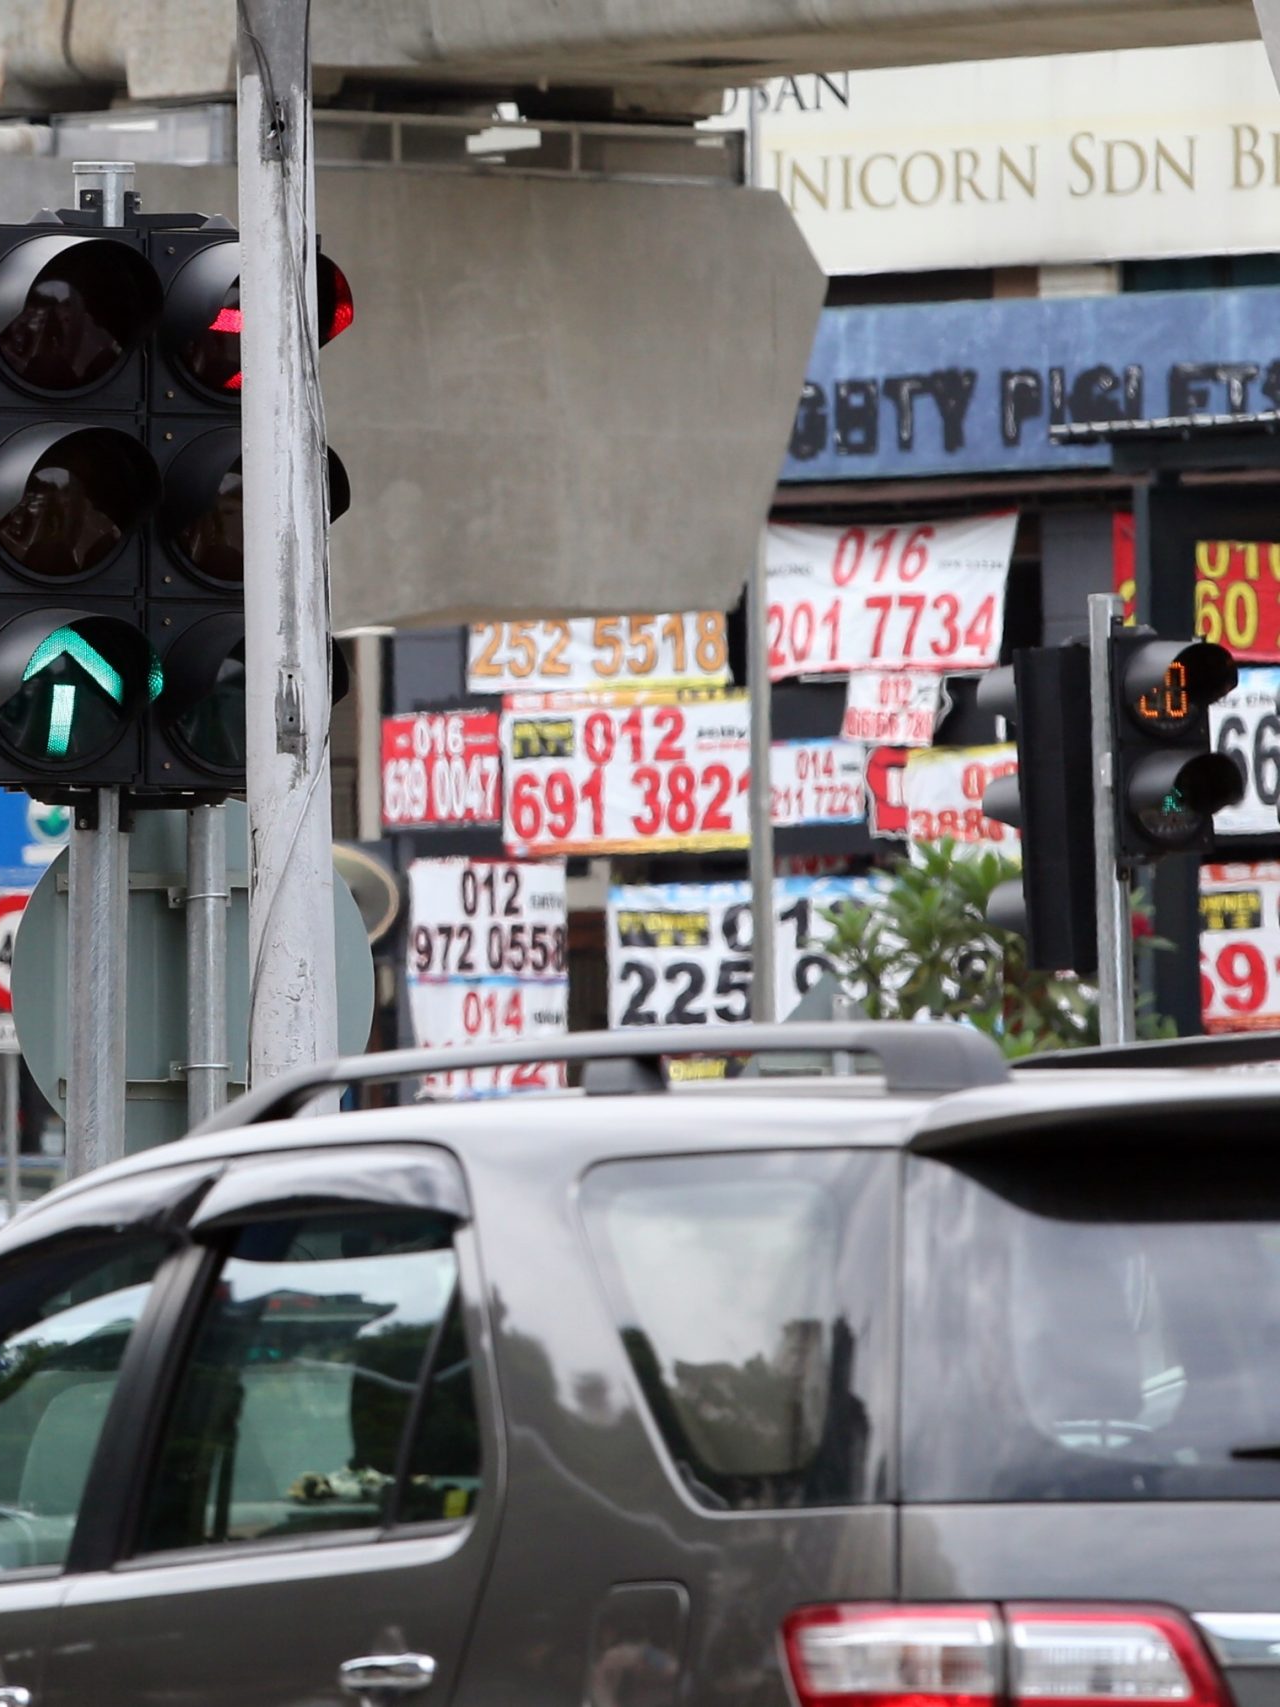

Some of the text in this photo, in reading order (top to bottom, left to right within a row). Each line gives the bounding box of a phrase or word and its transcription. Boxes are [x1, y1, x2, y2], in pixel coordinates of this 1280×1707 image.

[832, 526, 936, 588] 016
[471, 619, 572, 678] 252
[592, 611, 727, 677] 5518
[766, 594, 997, 668] 201 7734
[412, 715, 465, 759] 016
[583, 706, 686, 765] 012
[796, 749, 835, 781] 014
[511, 768, 604, 840] 691
[461, 867, 521, 917] 012
[415, 924, 474, 973] 972
[462, 989, 524, 1036] 014
